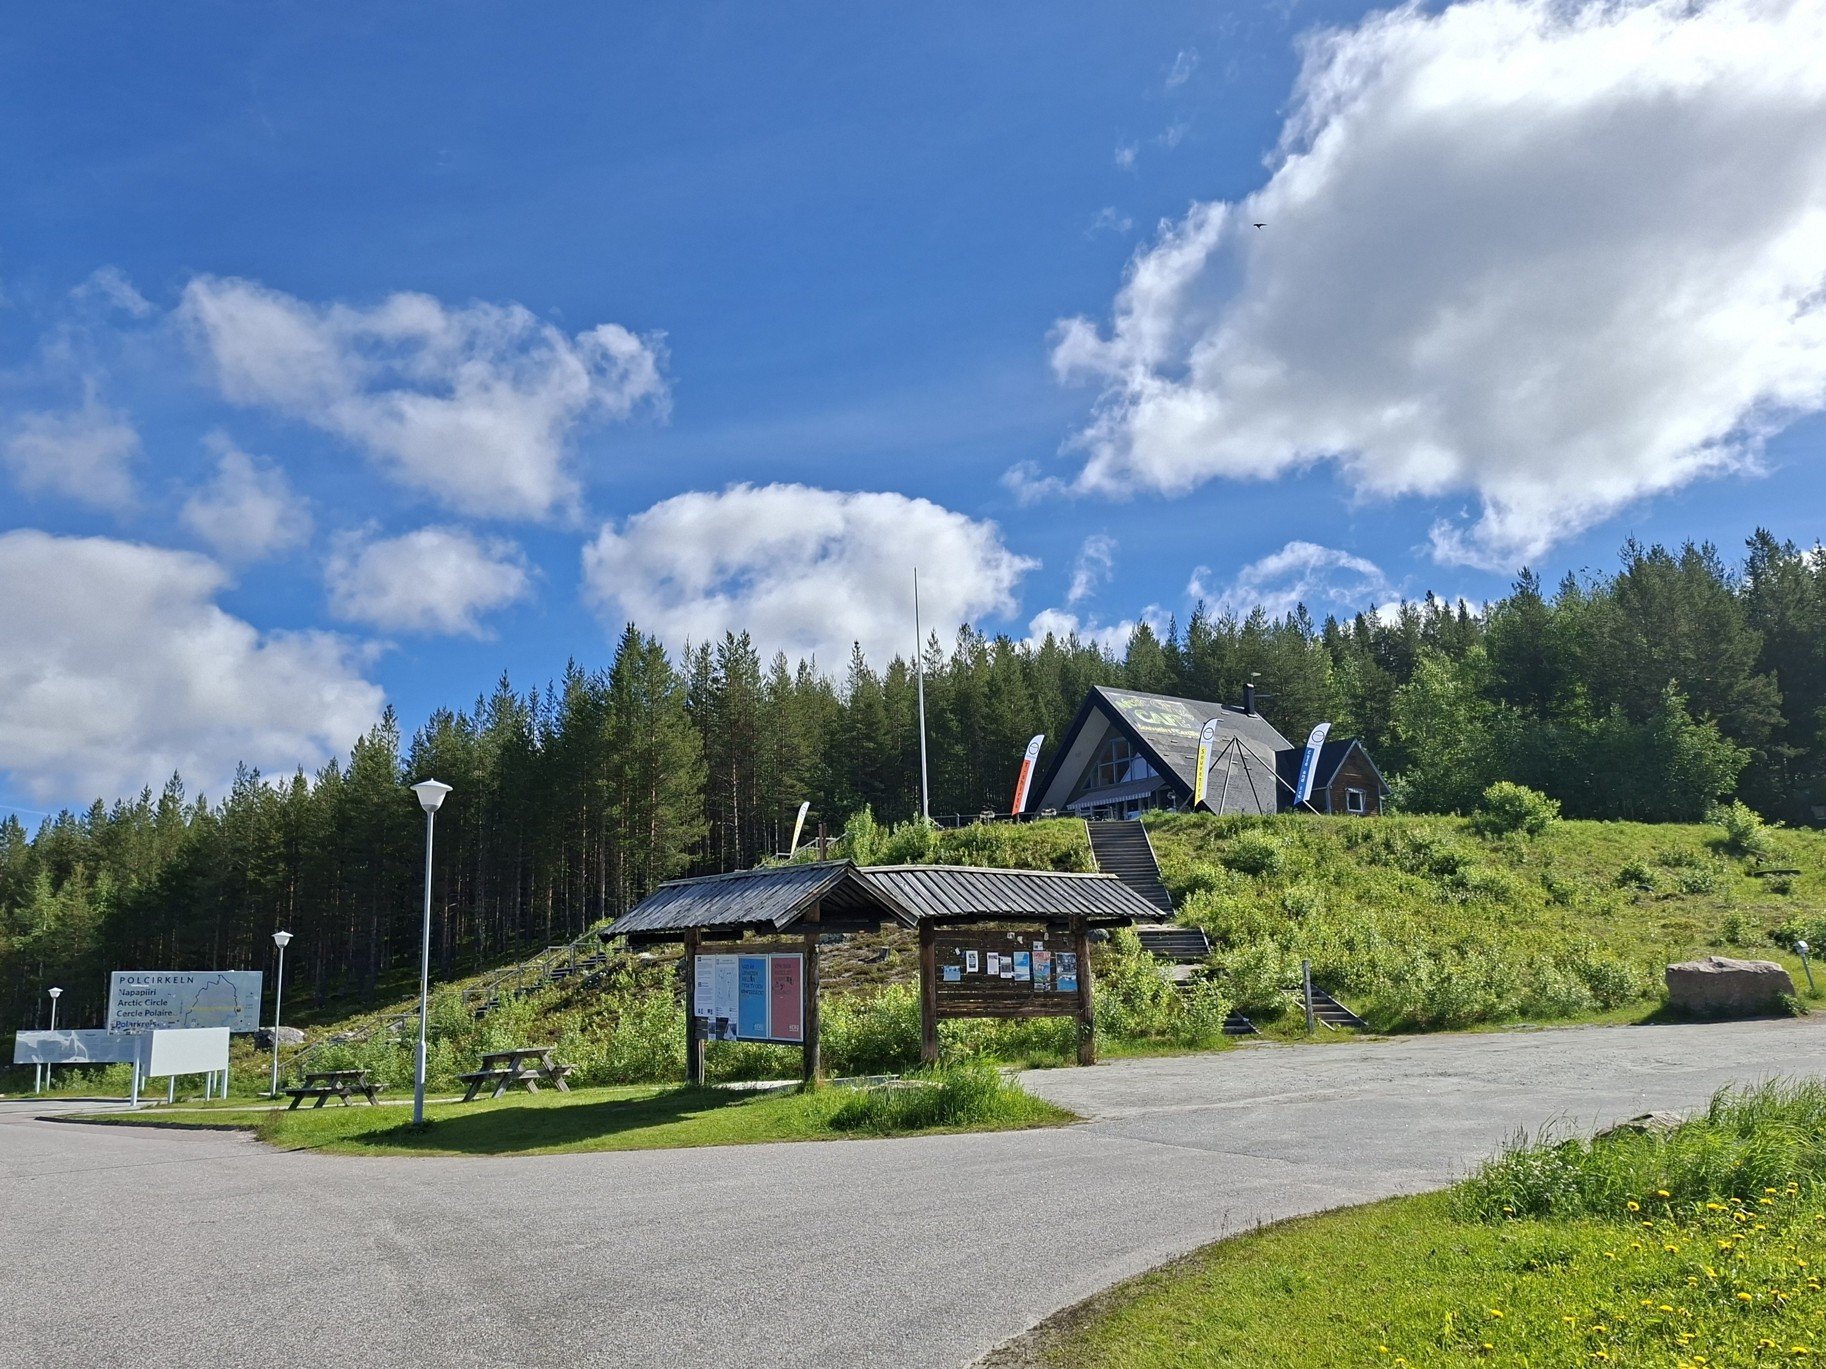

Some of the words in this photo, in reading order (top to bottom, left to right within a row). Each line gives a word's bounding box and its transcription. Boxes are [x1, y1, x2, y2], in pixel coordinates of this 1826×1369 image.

[119, 976, 194, 985] POLCIRKELN
[118, 988, 157, 997] Napapiiri
[117, 999, 143, 1007] Arctic
[144, 998, 168, 1006] Circle
[116, 1009, 143, 1018] Cercle
[145, 1009, 173, 1017] Polaire
